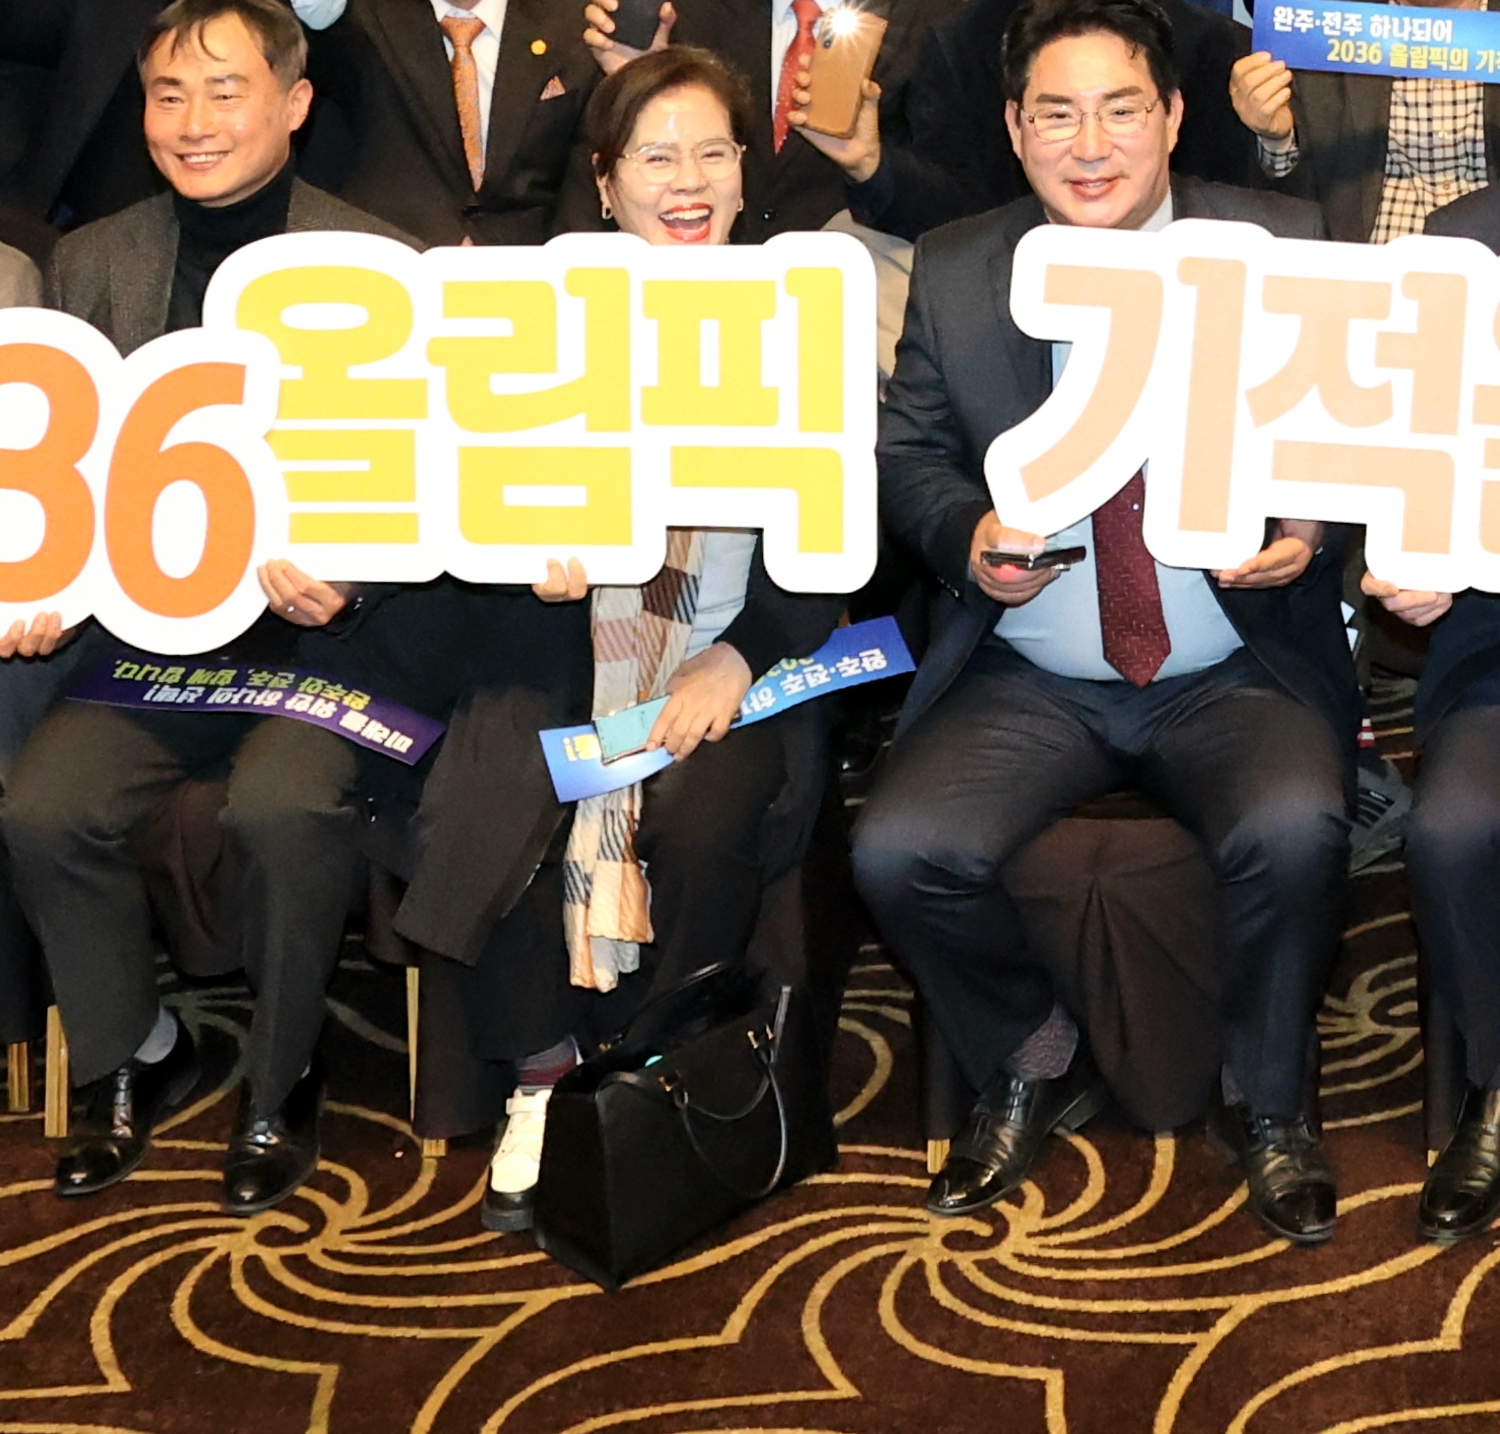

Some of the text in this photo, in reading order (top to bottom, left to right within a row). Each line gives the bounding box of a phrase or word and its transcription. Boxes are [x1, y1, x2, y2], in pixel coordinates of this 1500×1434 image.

[1273, 6, 1453, 44] 완주·전주 하나되어
[1327, 39, 1468, 72] 2036 올림픽의
[235, 266, 844, 554] 올림픽
[187, 667, 371, 711] 완주와 함께
[780, 647, 888, 697] 완주·전주
[143, 683, 413, 754] 미래를 위한 하나의 선택!
